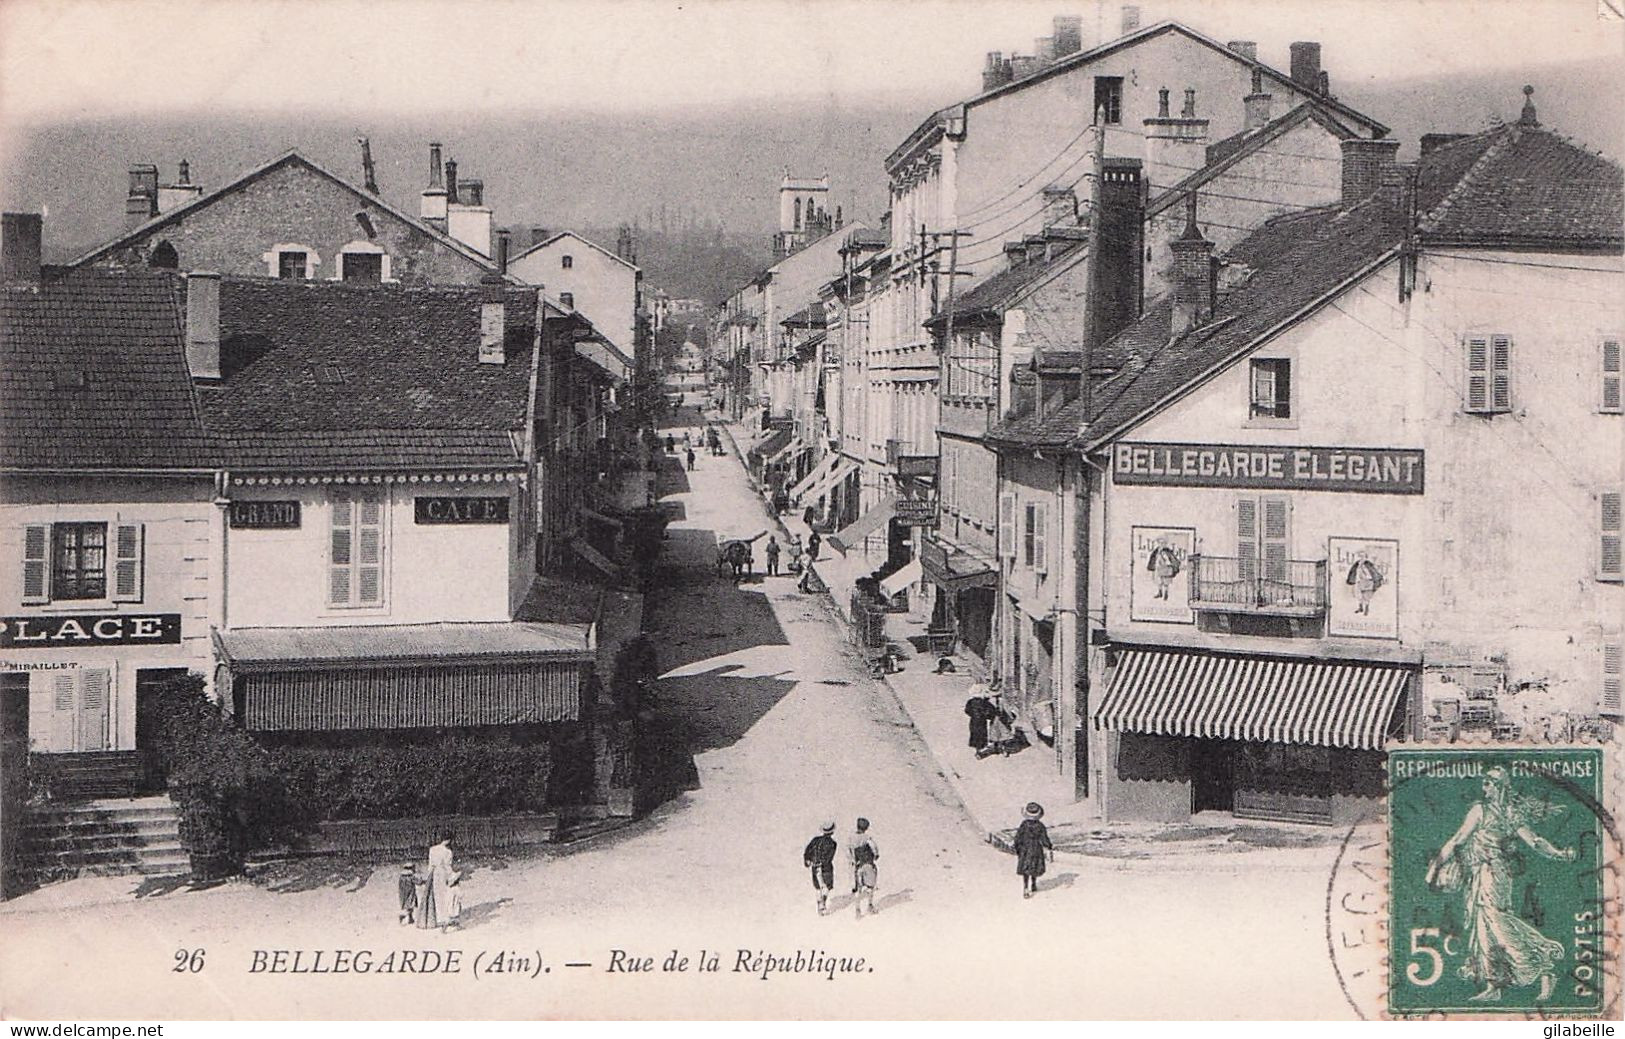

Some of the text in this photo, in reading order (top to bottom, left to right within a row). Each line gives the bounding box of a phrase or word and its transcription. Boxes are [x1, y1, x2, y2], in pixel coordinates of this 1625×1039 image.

[1115, 444, 1285, 479] BELLEGARDE
[234, 503, 295, 523] GRAND
[0, 618, 162, 641] LACE
[172, 948, 205, 973] 26
[249, 950, 463, 974] BELLEGARDE
[472, 950, 551, 980] (Ain).
[605, 949, 654, 974] Rue
[662, 949, 689, 974] de
[731, 948, 875, 981] République.
[1575, 910, 1593, 997] POSTES
